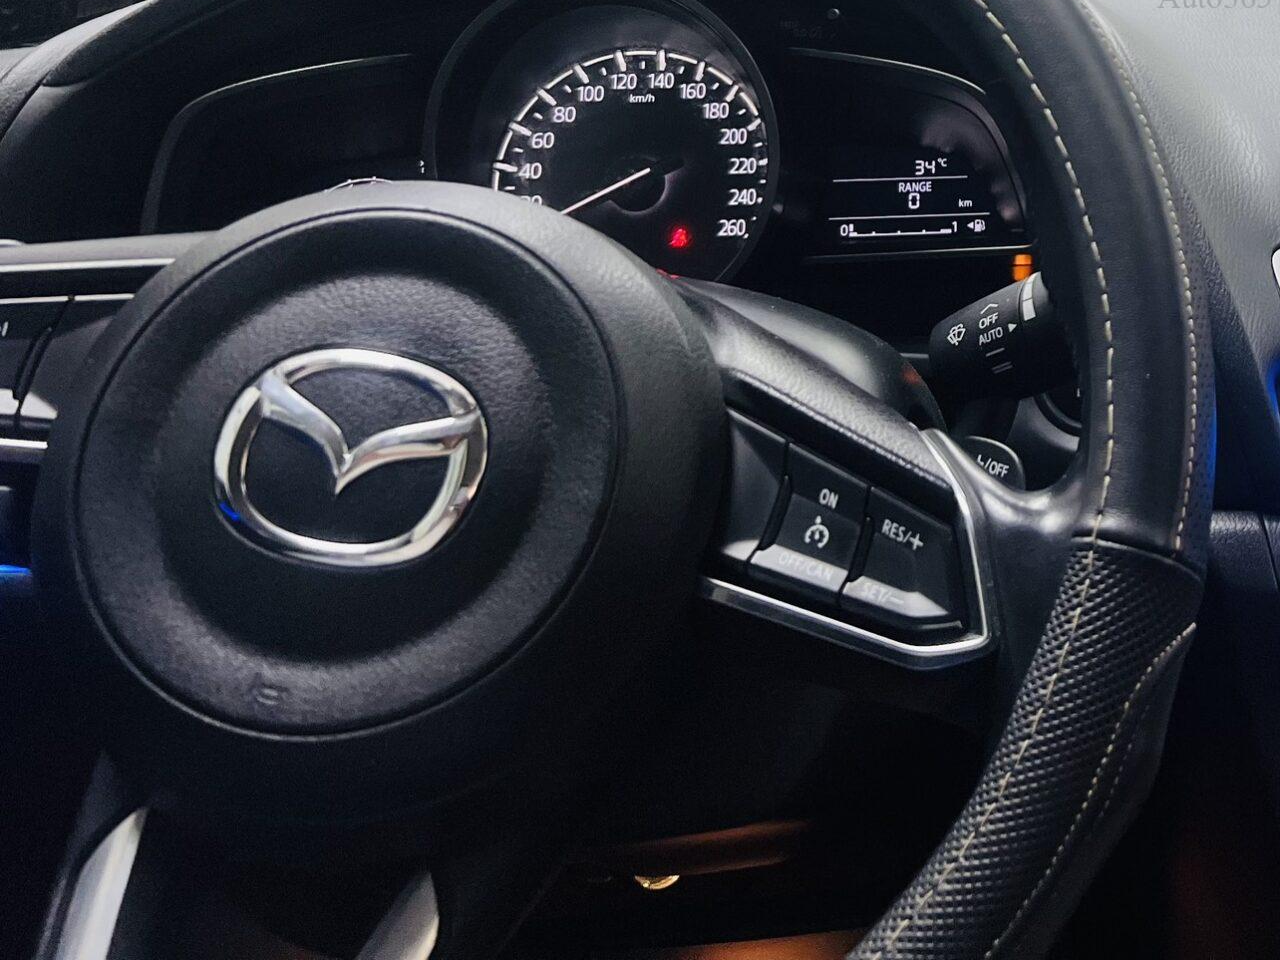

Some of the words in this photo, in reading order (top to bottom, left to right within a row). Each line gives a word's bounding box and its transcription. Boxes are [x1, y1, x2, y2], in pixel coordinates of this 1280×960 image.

[611, 73, 638, 90] 120
[648, 73, 675, 89] 140
[577, 85, 605, 102] 100
[629, 93, 655, 104] km/h
[680, 83, 706, 100] 160
[553, 107, 577, 123] 80
[702, 102, 730, 119] 180
[531, 133, 555, 149] 60
[719, 128, 748, 145] 200
[518, 162, 543, 180] 40
[728, 157, 757, 175] 220
[898, 182, 932, 192] RANGE
[728, 189, 757, 206] 240
[908, 193, 920, 209] 0
[958, 198, 973, 208] km
[717, 219, 747, 237] 260
[840, 224, 848, 237] 0
[951, 221, 958, 233] 1
[978, 312, 999, 329] OFF
[978, 326, 1004, 346] AUTO
[819, 488, 839, 510] ON
[882, 518, 924, 551] RES/+
[778, 551, 834, 582] OFF/CAN
